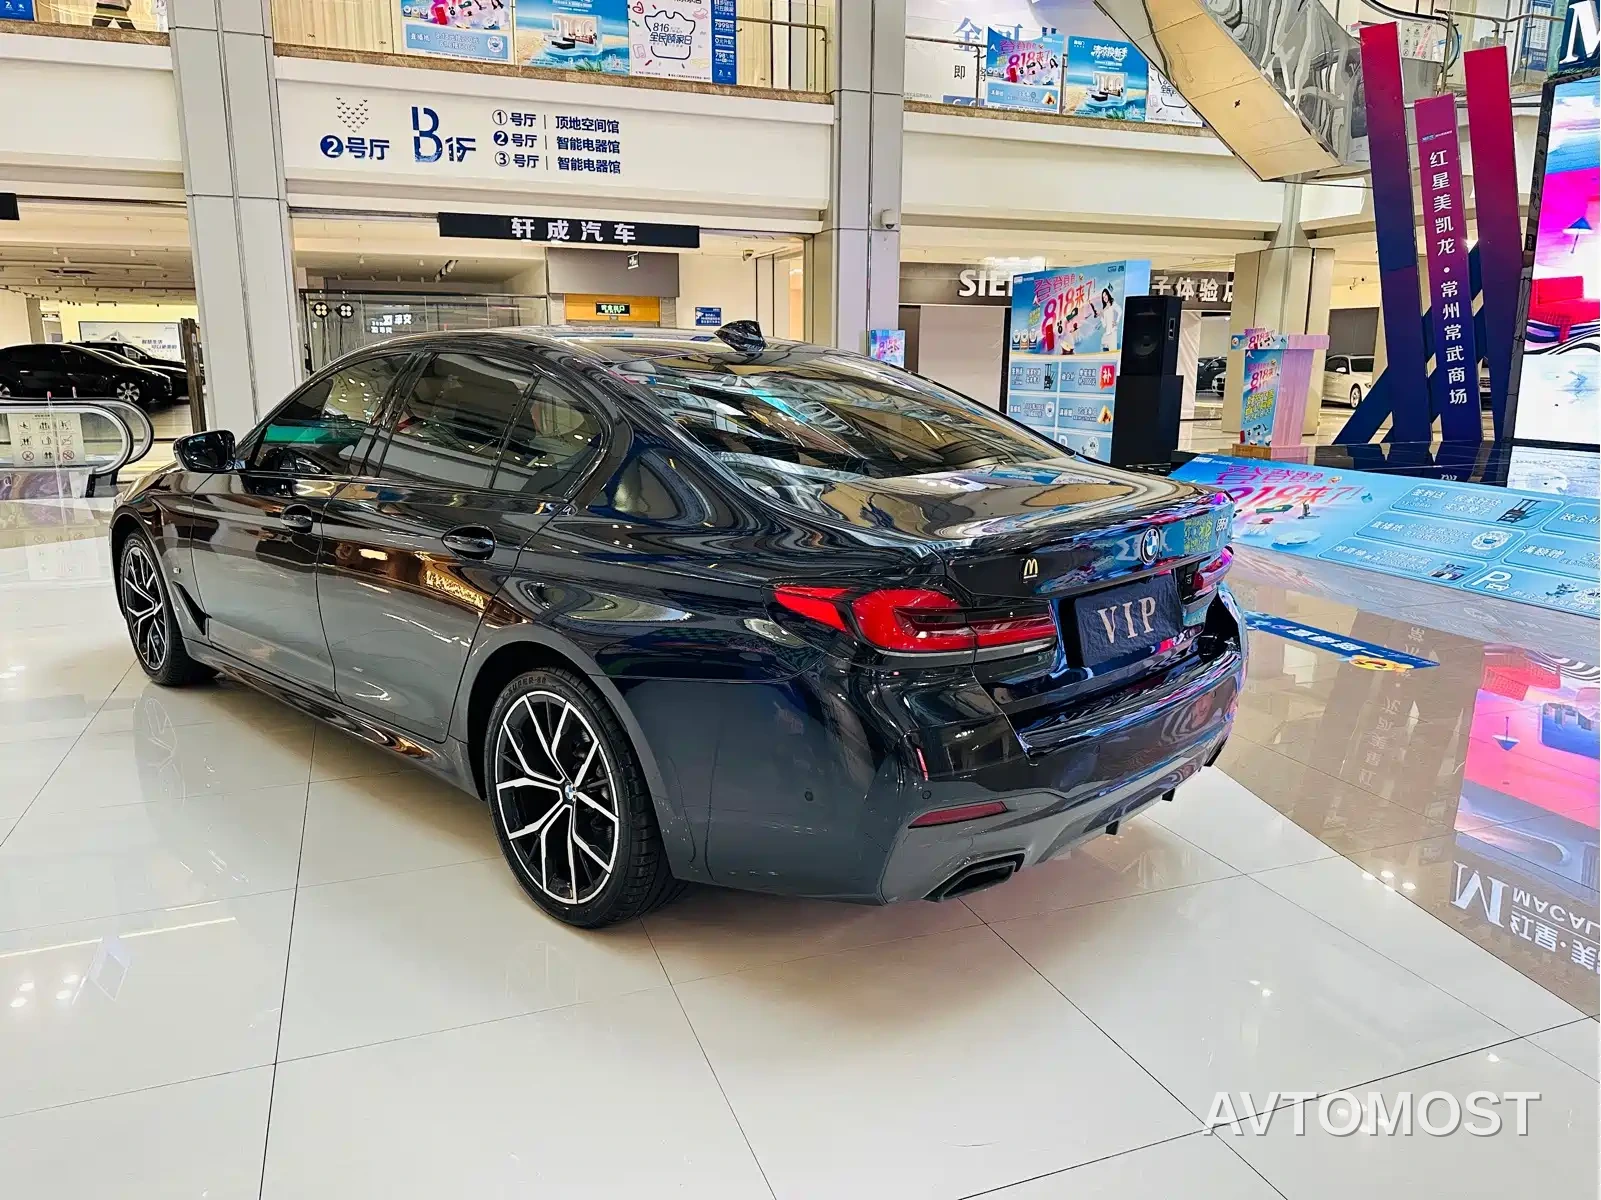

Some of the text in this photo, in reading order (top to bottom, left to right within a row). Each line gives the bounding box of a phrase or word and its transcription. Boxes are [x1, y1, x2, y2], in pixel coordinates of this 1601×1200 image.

[653, 22, 670, 32] 816
[554, 115, 620, 134] 顶地空间馆
[556, 136, 621, 155] 智能电器馆
[557, 156, 621, 174] 智能电器馆
[510, 217, 637, 244] 轩成汽车
[1098, 596, 1156, 645] VIP
